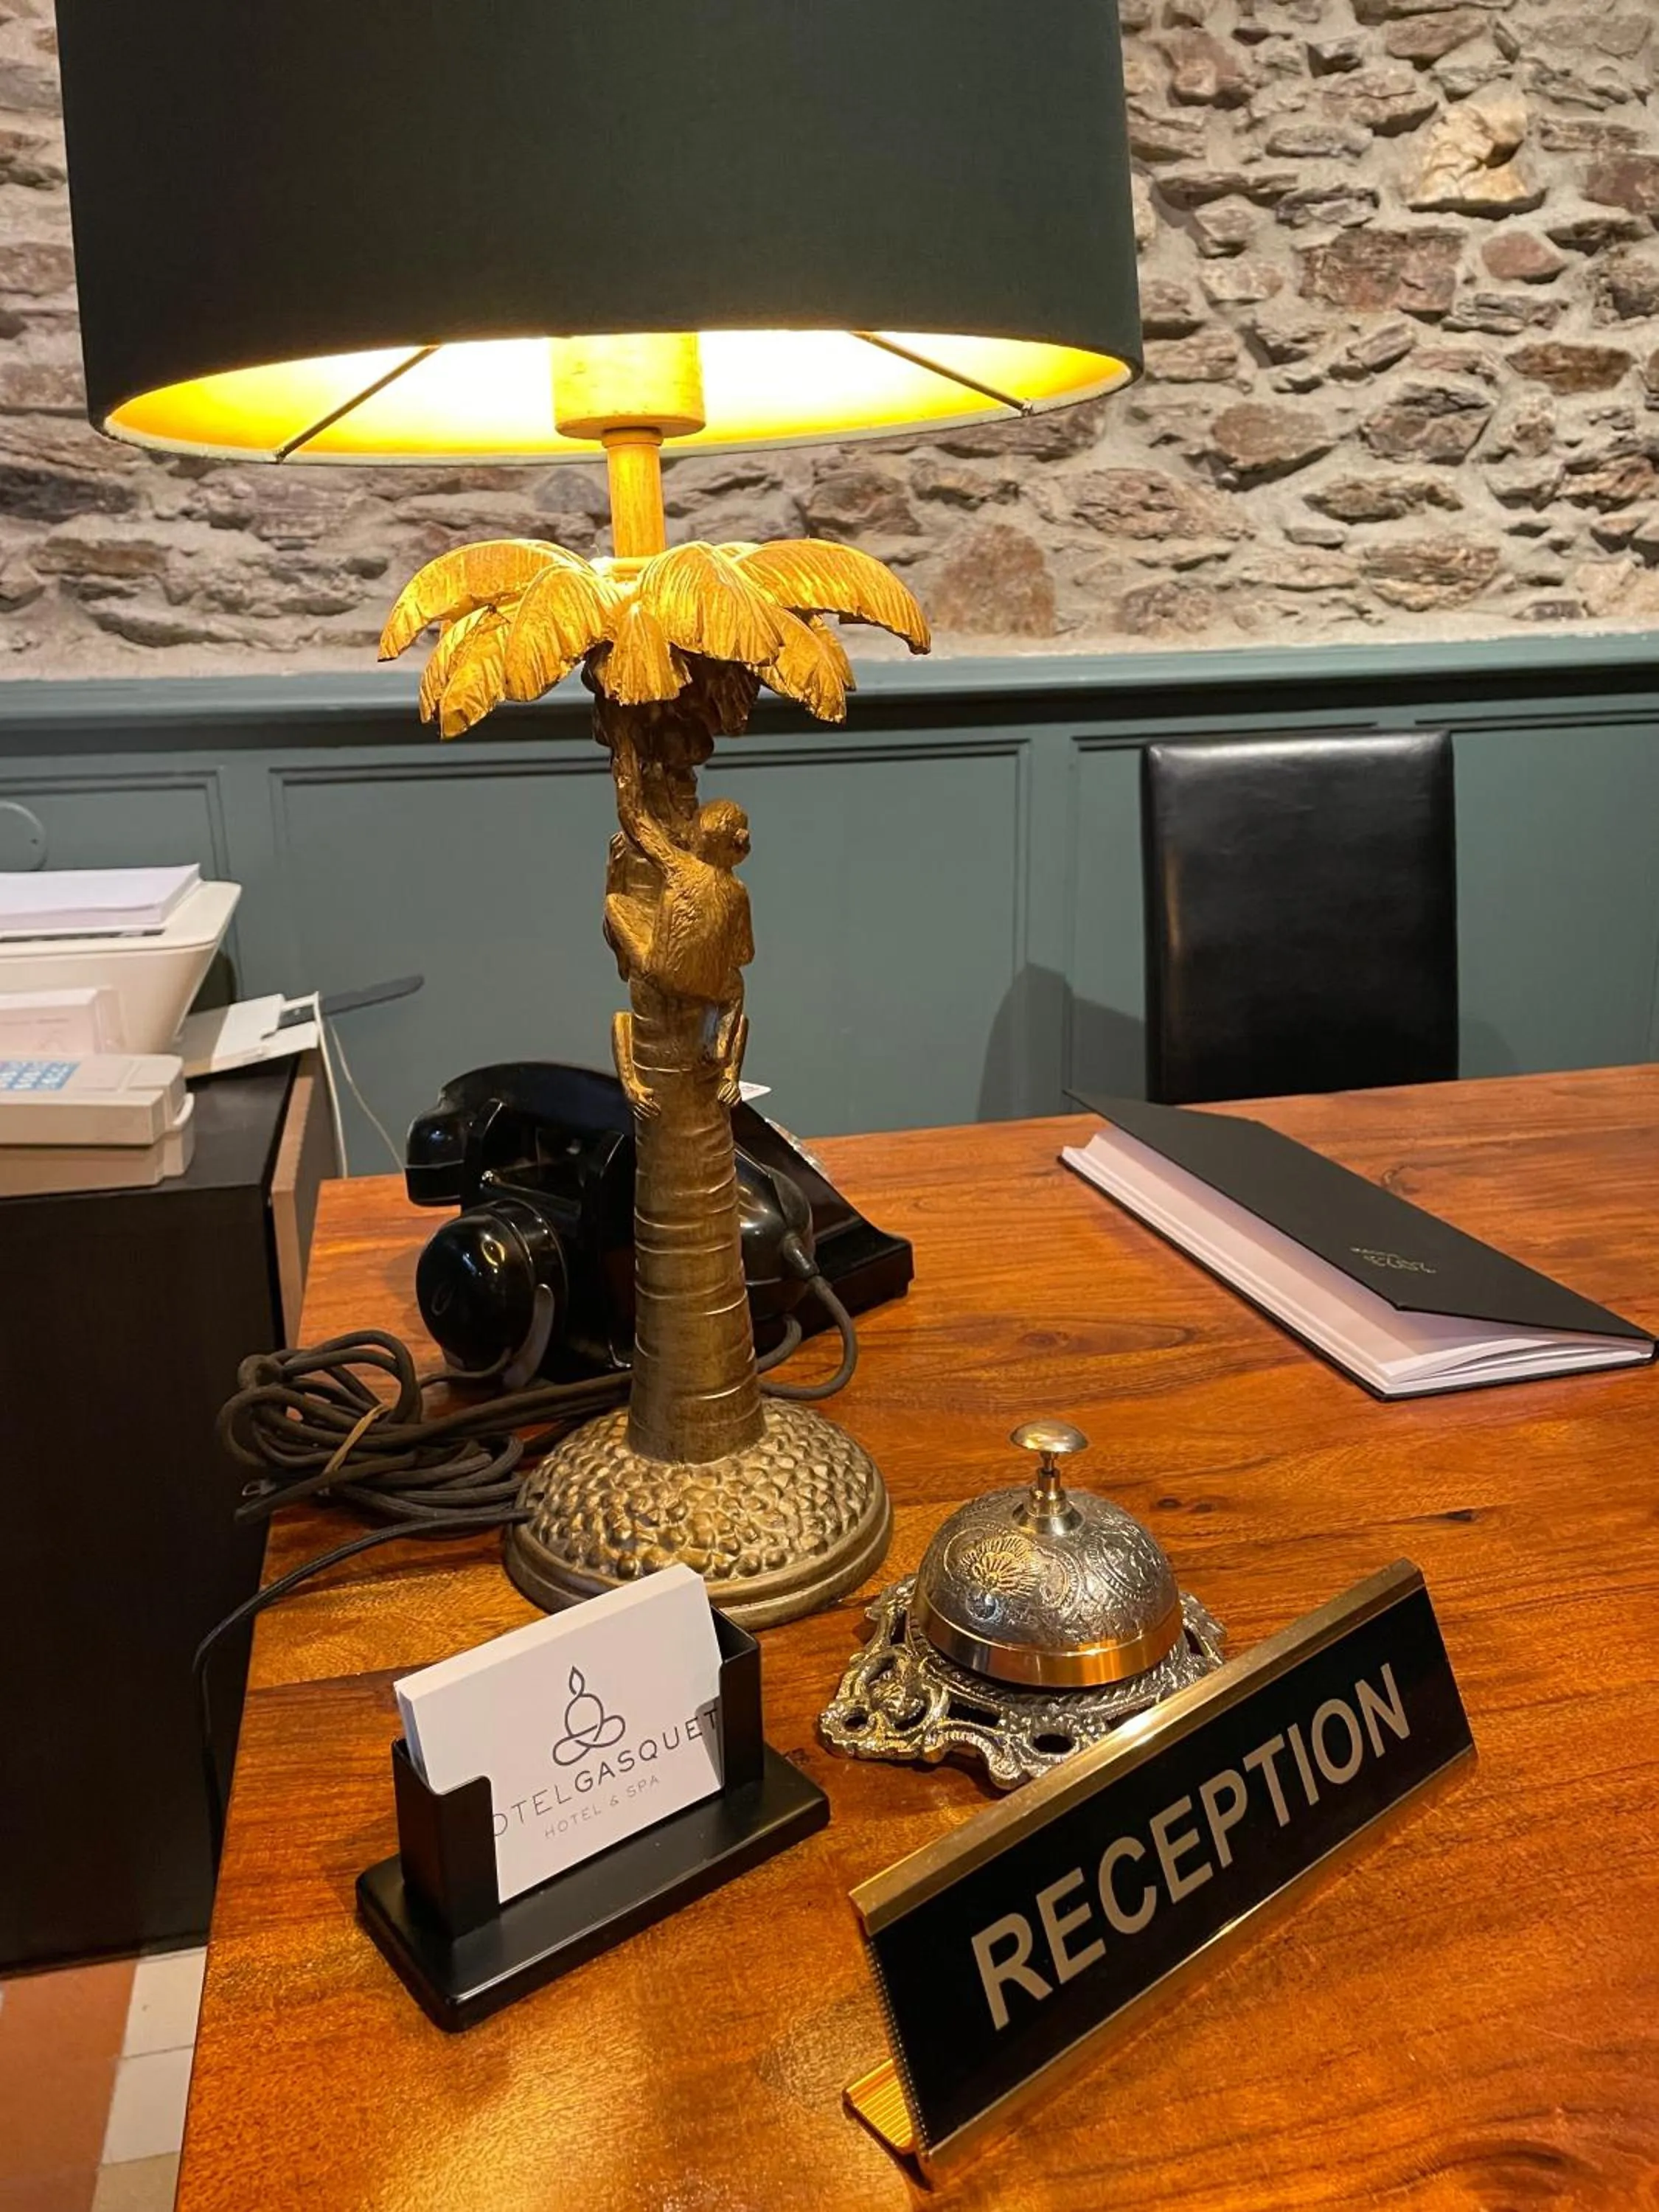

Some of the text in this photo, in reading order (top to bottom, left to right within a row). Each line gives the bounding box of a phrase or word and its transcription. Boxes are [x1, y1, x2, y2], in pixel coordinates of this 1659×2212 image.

[493, 1707, 718, 1837] OTELGASQUET
[544, 1775, 661, 1839] HOTEL & SPA
[970, 1663, 1411, 2031] RECEPTION
